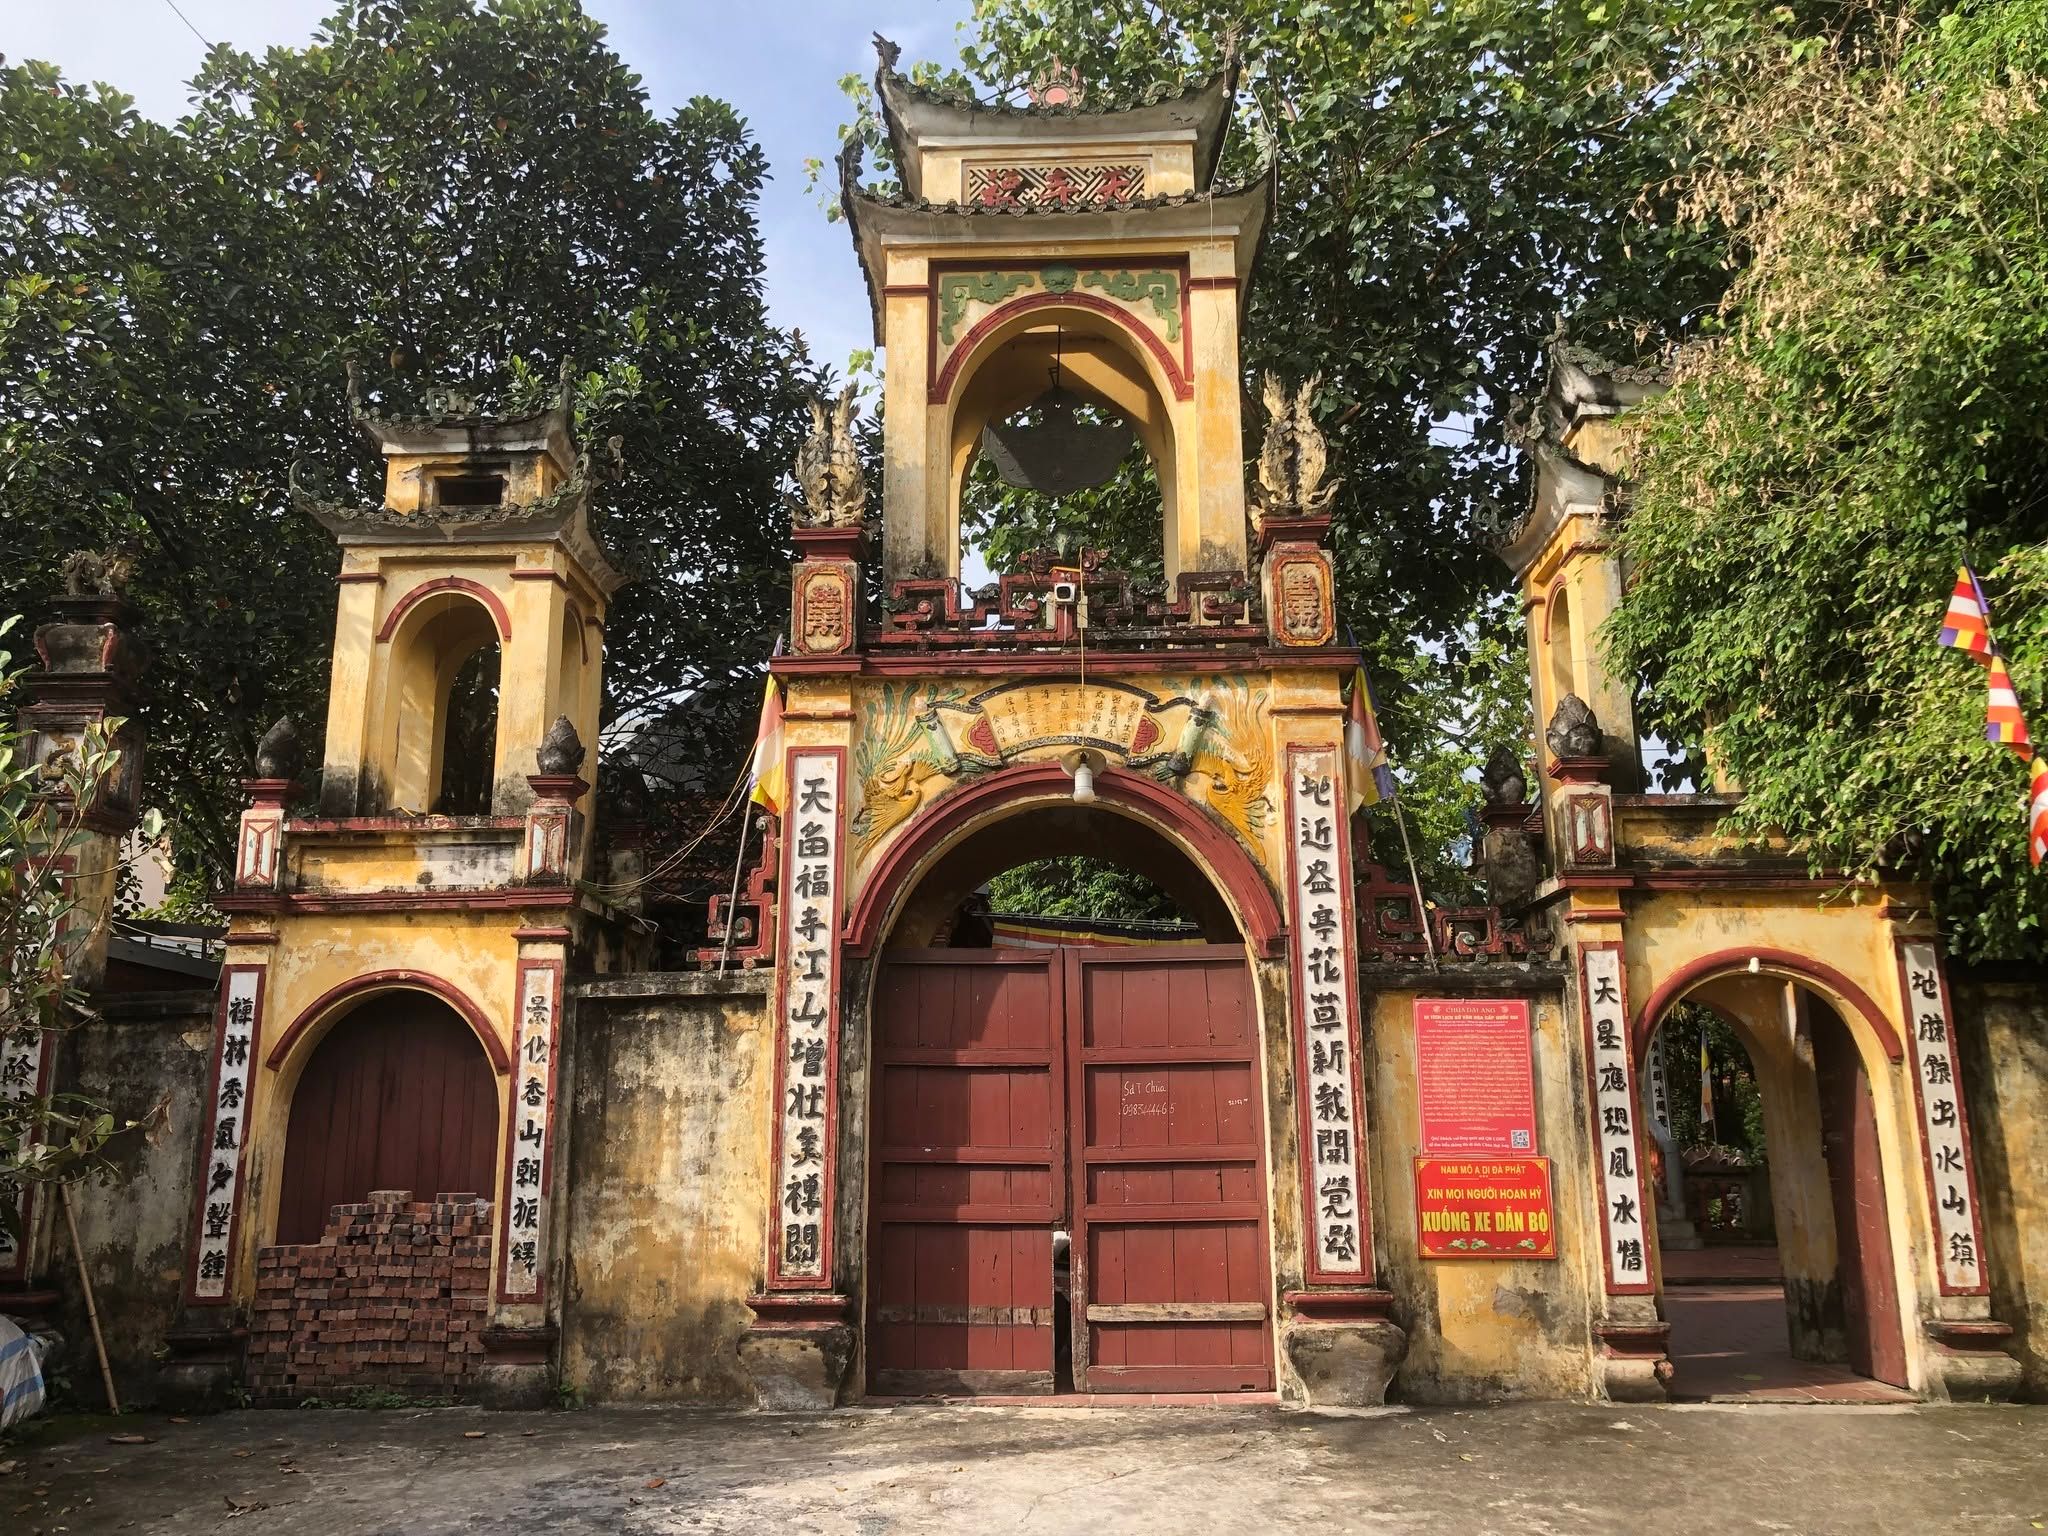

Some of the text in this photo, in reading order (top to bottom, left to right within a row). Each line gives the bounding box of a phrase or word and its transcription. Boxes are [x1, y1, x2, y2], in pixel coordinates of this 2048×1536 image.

[1440, 1165, 1459, 1174] NAM
[1460, 1164, 1473, 1174] MÔ
[1505, 1164, 1527, 1176] PHẬT
[1427, 1188, 1444, 1199] XIN
[1446, 1188, 1464, 1202] MỌI
[1466, 1186, 1498, 1199] NGƯỜI
[1500, 1188, 1527, 1199] HOAN
[1422, 1205, 1549, 1236] XUỐNG XE DẪN BỘ
